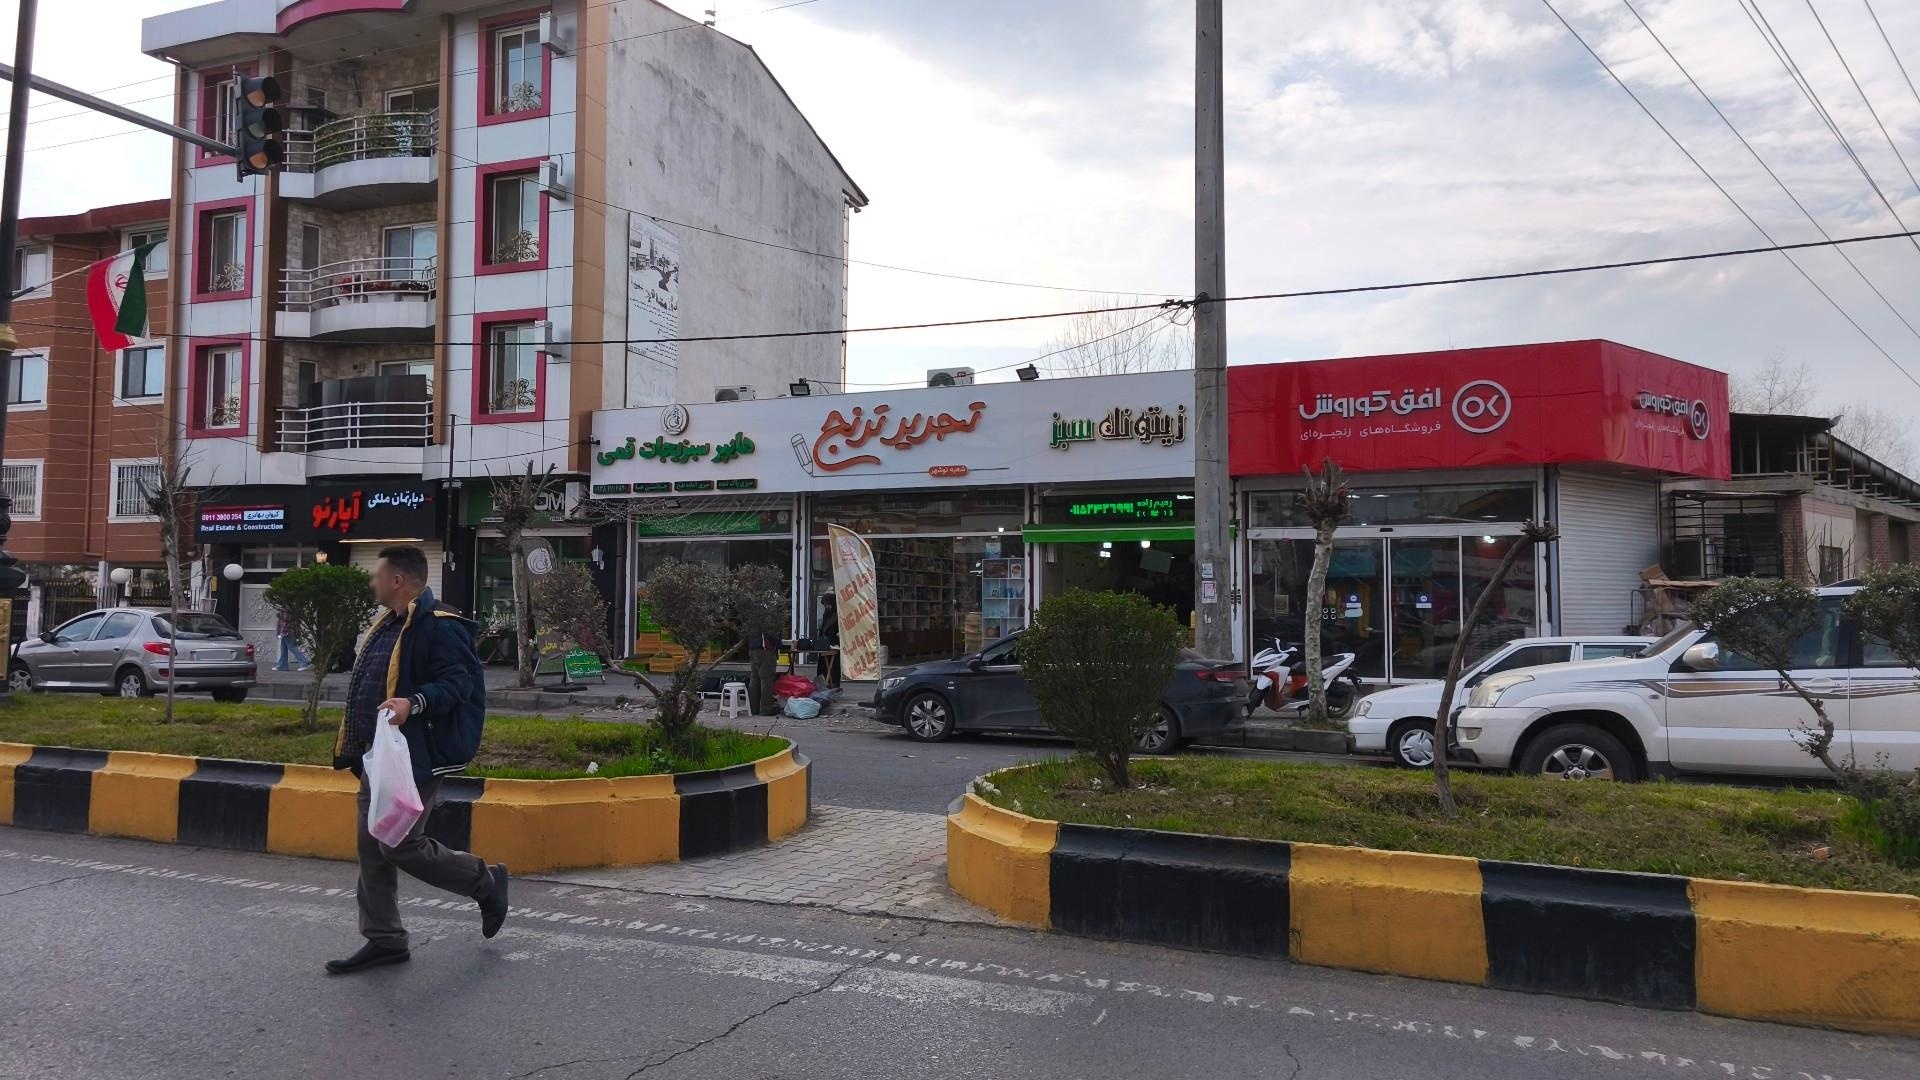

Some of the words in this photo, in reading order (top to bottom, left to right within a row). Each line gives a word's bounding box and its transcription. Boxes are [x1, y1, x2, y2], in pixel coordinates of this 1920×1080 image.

[1299, 390, 1392, 420] کوروش
[1391, 387, 1442, 415] افق
[813, 404, 890, 472] ترنج
[880, 402, 987, 450] تحریر
[1050, 411, 1096, 450] سبز
[597, 436, 636, 466] قمی
[639, 436, 711, 464] سبزیجات
[711, 432, 756, 464] هایپر
[313, 491, 361, 533] آپارنو
[367, 493, 390, 508] ملکی
[391, 490, 425, 509] دپارتمان
[200, 524, 215, 532] Real
[243, 523, 284, 531] Construction
